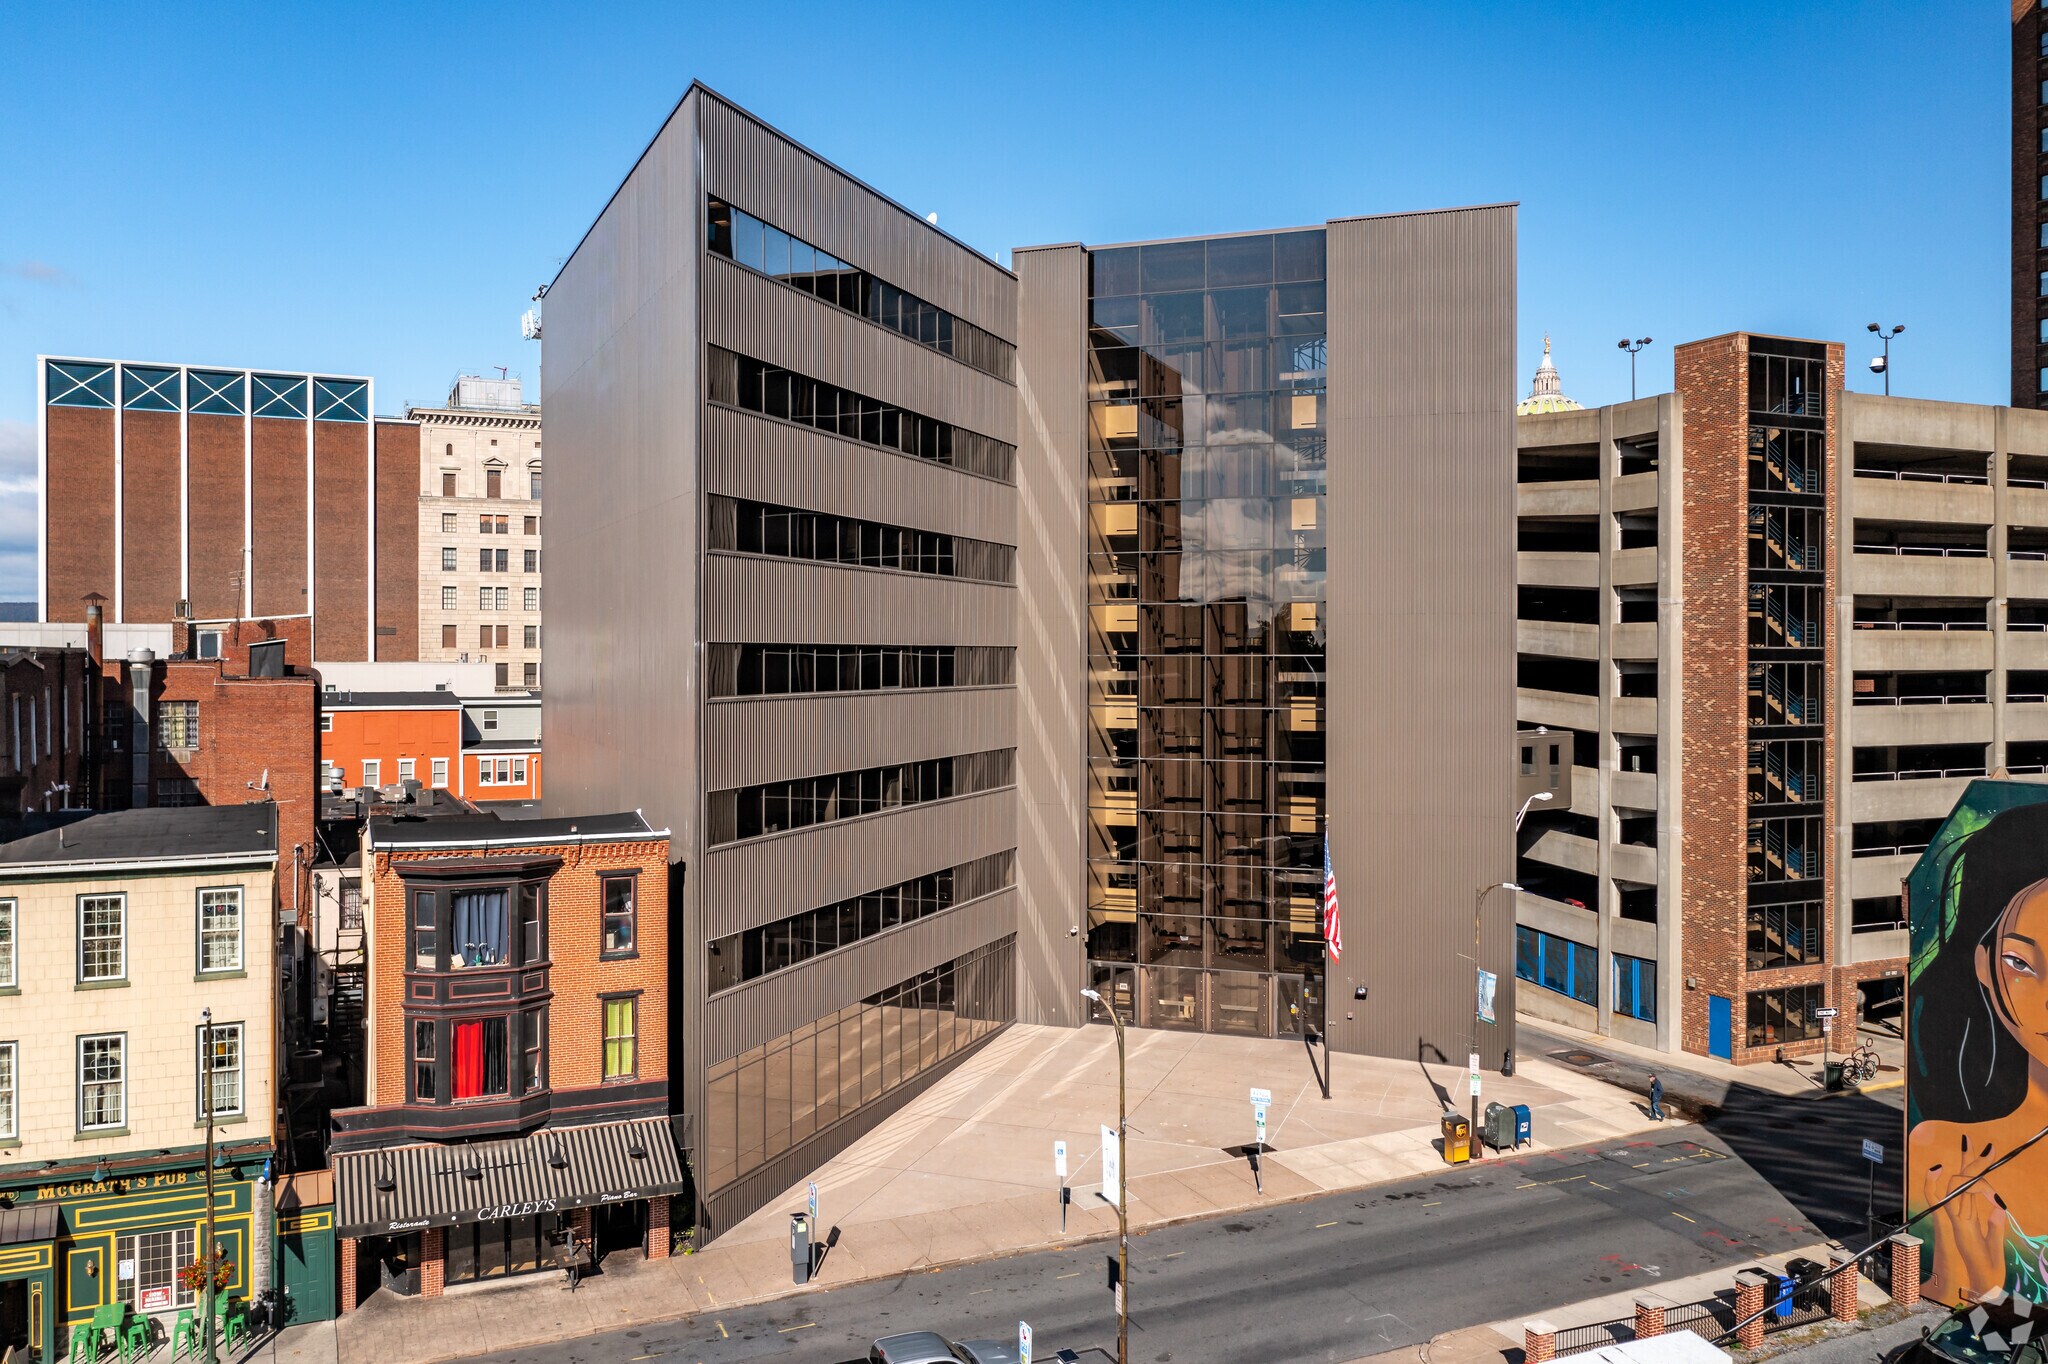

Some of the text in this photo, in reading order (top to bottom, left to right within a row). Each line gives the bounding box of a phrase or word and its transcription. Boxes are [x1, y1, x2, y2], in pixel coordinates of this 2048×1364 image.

[153, 1172, 187, 1187] PUB
[389, 1191, 638, 1230] Ristorante CARLEY'S Piano Bar
